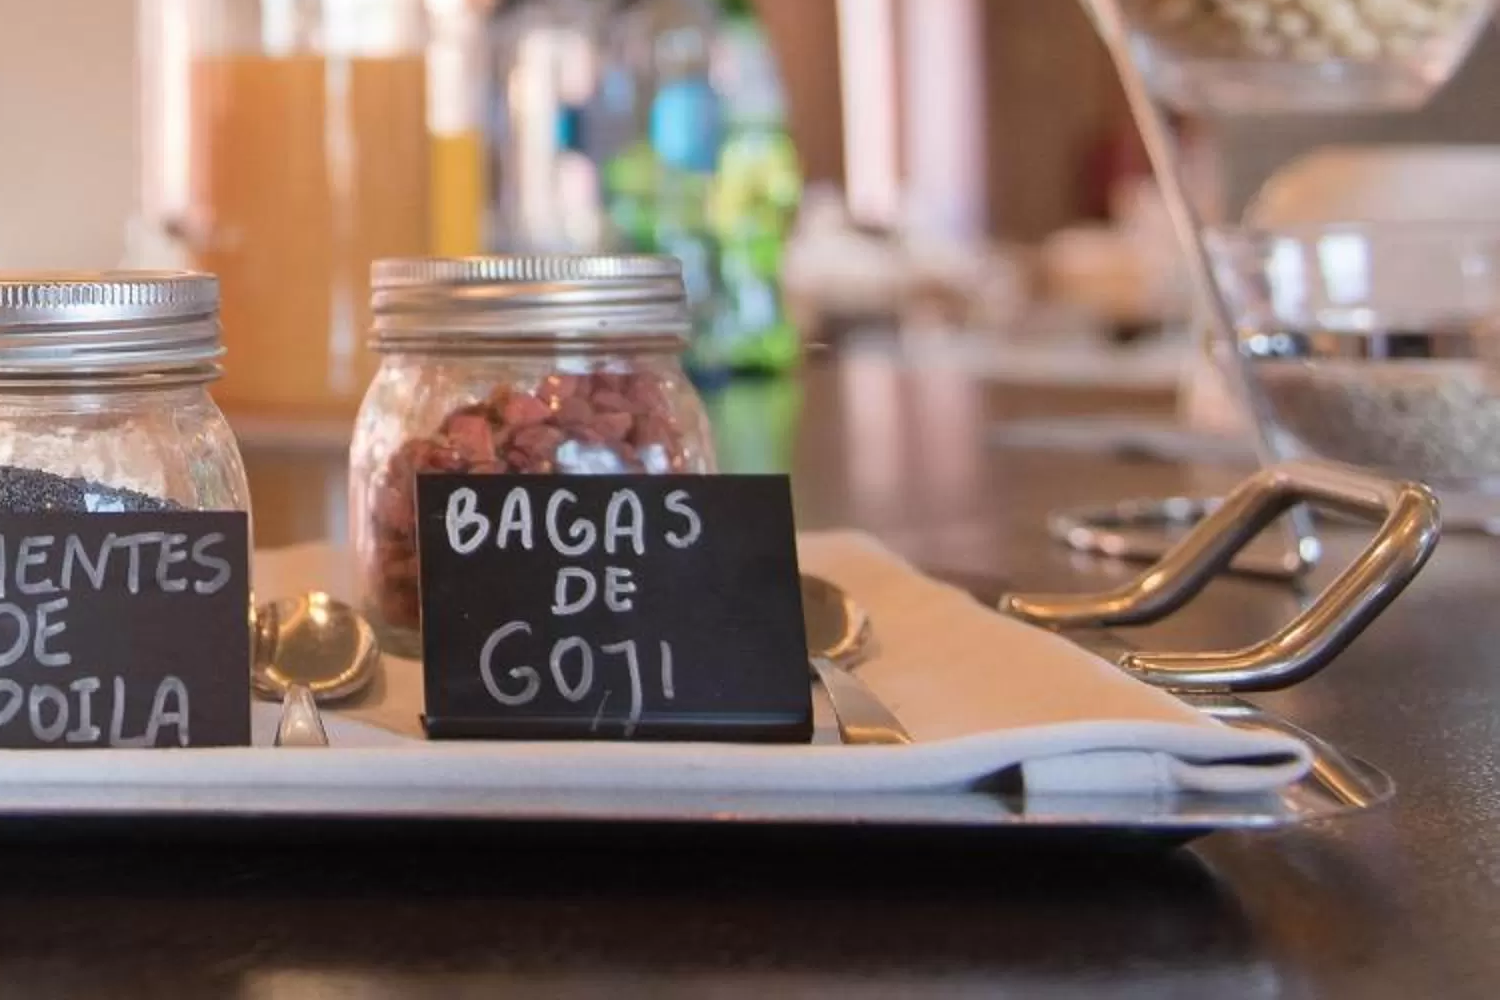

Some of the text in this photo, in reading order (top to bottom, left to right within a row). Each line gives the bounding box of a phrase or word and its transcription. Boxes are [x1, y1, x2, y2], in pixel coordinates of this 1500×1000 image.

[445, 486, 702, 556] BAGAS
[550, 566, 637, 616] DE
[479, 620, 675, 737] GOJI
